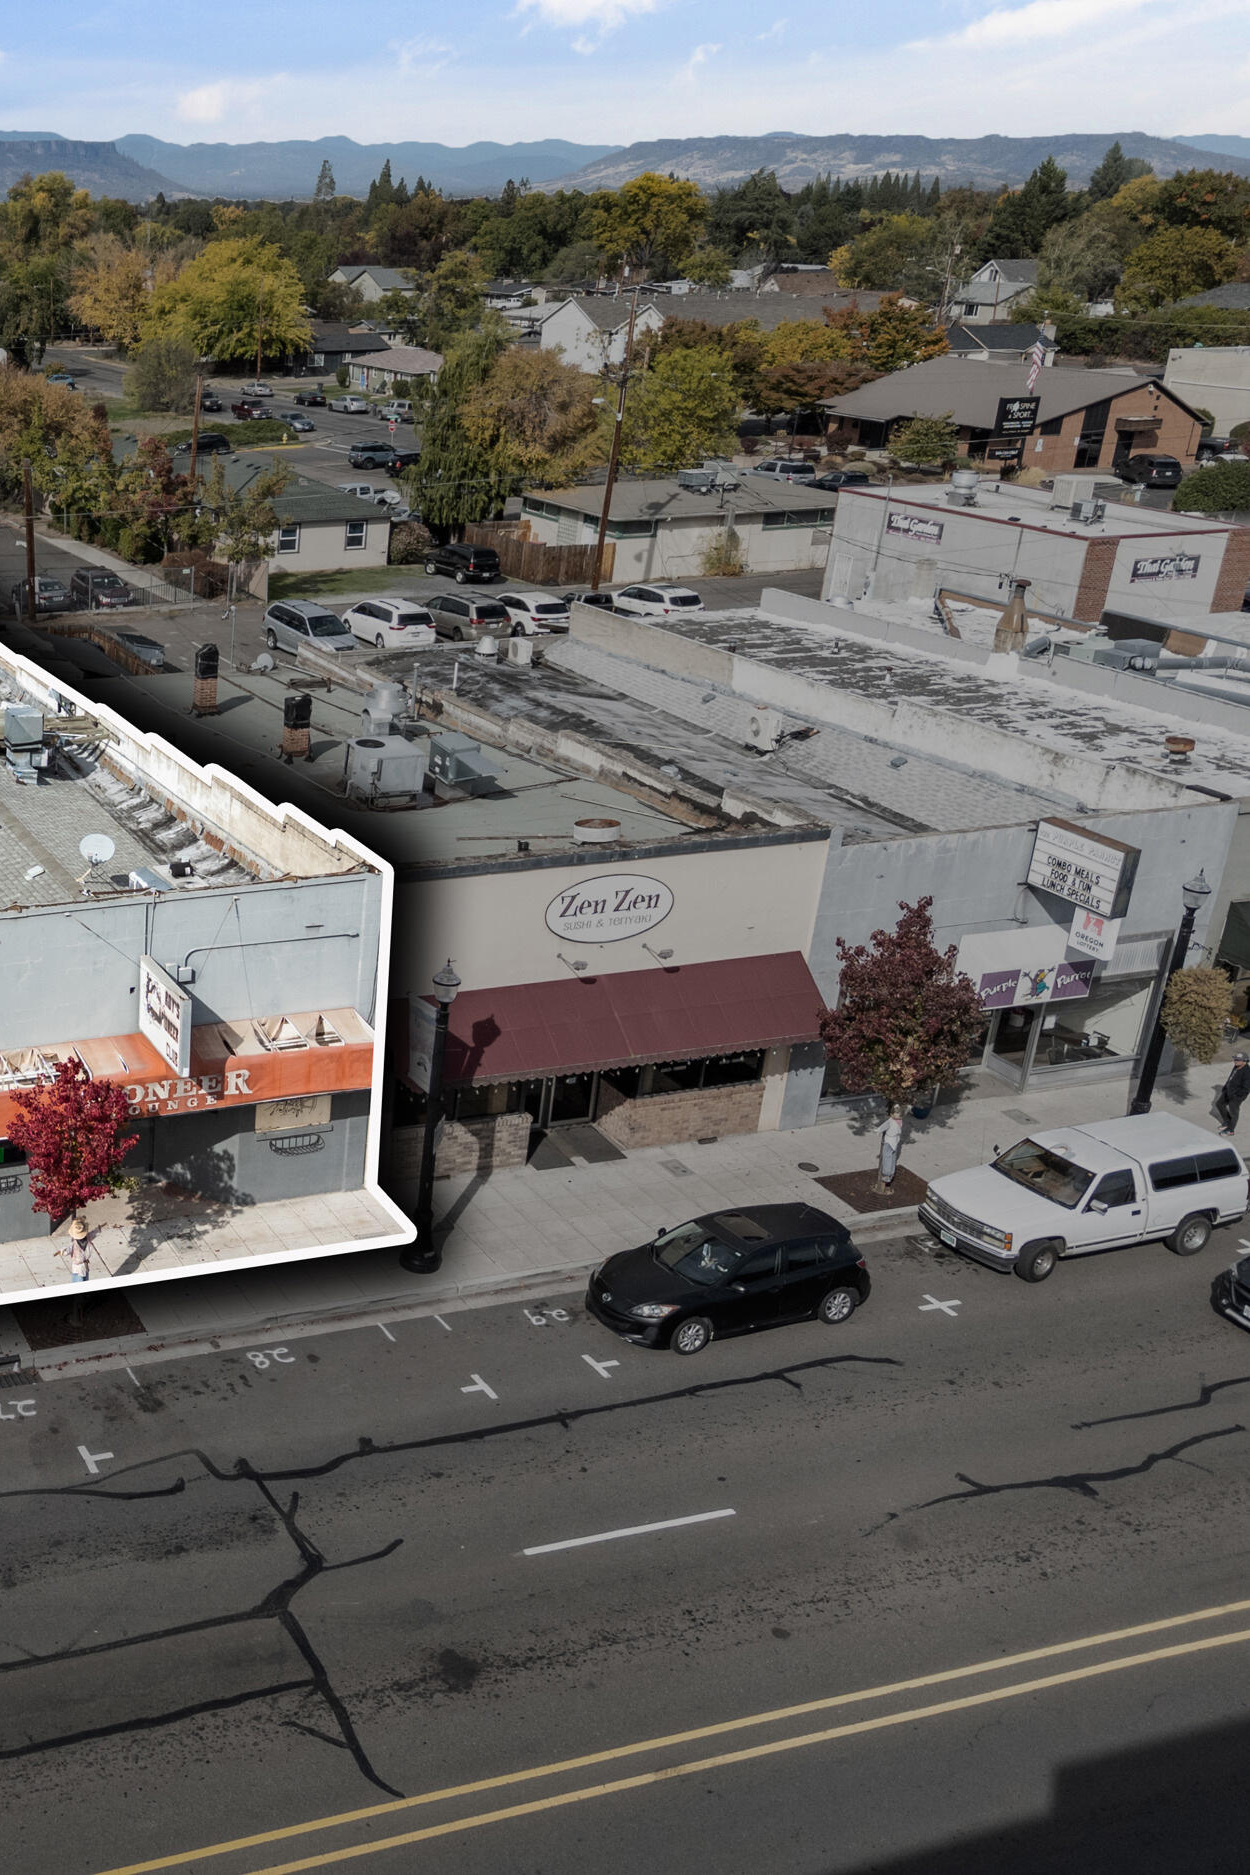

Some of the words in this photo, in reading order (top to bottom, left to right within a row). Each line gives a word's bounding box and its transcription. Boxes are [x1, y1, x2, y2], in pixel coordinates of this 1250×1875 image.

[891, 514, 911, 529] Thai
[1137, 559, 1161, 574] Thai
[1047, 855, 1071, 873] COMBO
[1074, 866, 1101, 886] MEALS
[1050, 868, 1069, 884] FOOD
[1071, 877, 1077, 888] &
[558, 892, 607, 918] Zen
[612, 887, 661, 912] Zen
[1041, 876, 1065, 894] LUNCH
[1066, 887, 1101, 910] SPECIALS
[563, 920, 592, 931] SUSHI
[595, 918, 604, 928] &
[1075, 931, 1104, 948] OREGON
[980, 978, 1018, 1000] Purple
[1056, 971, 1091, 989] Parrot
[123, 1069, 253, 1104] ONEER
[128, 1094, 218, 1116] OUNGE
[523, 1309, 570, 1326] 29
[246, 1347, 296, 1369] 28
